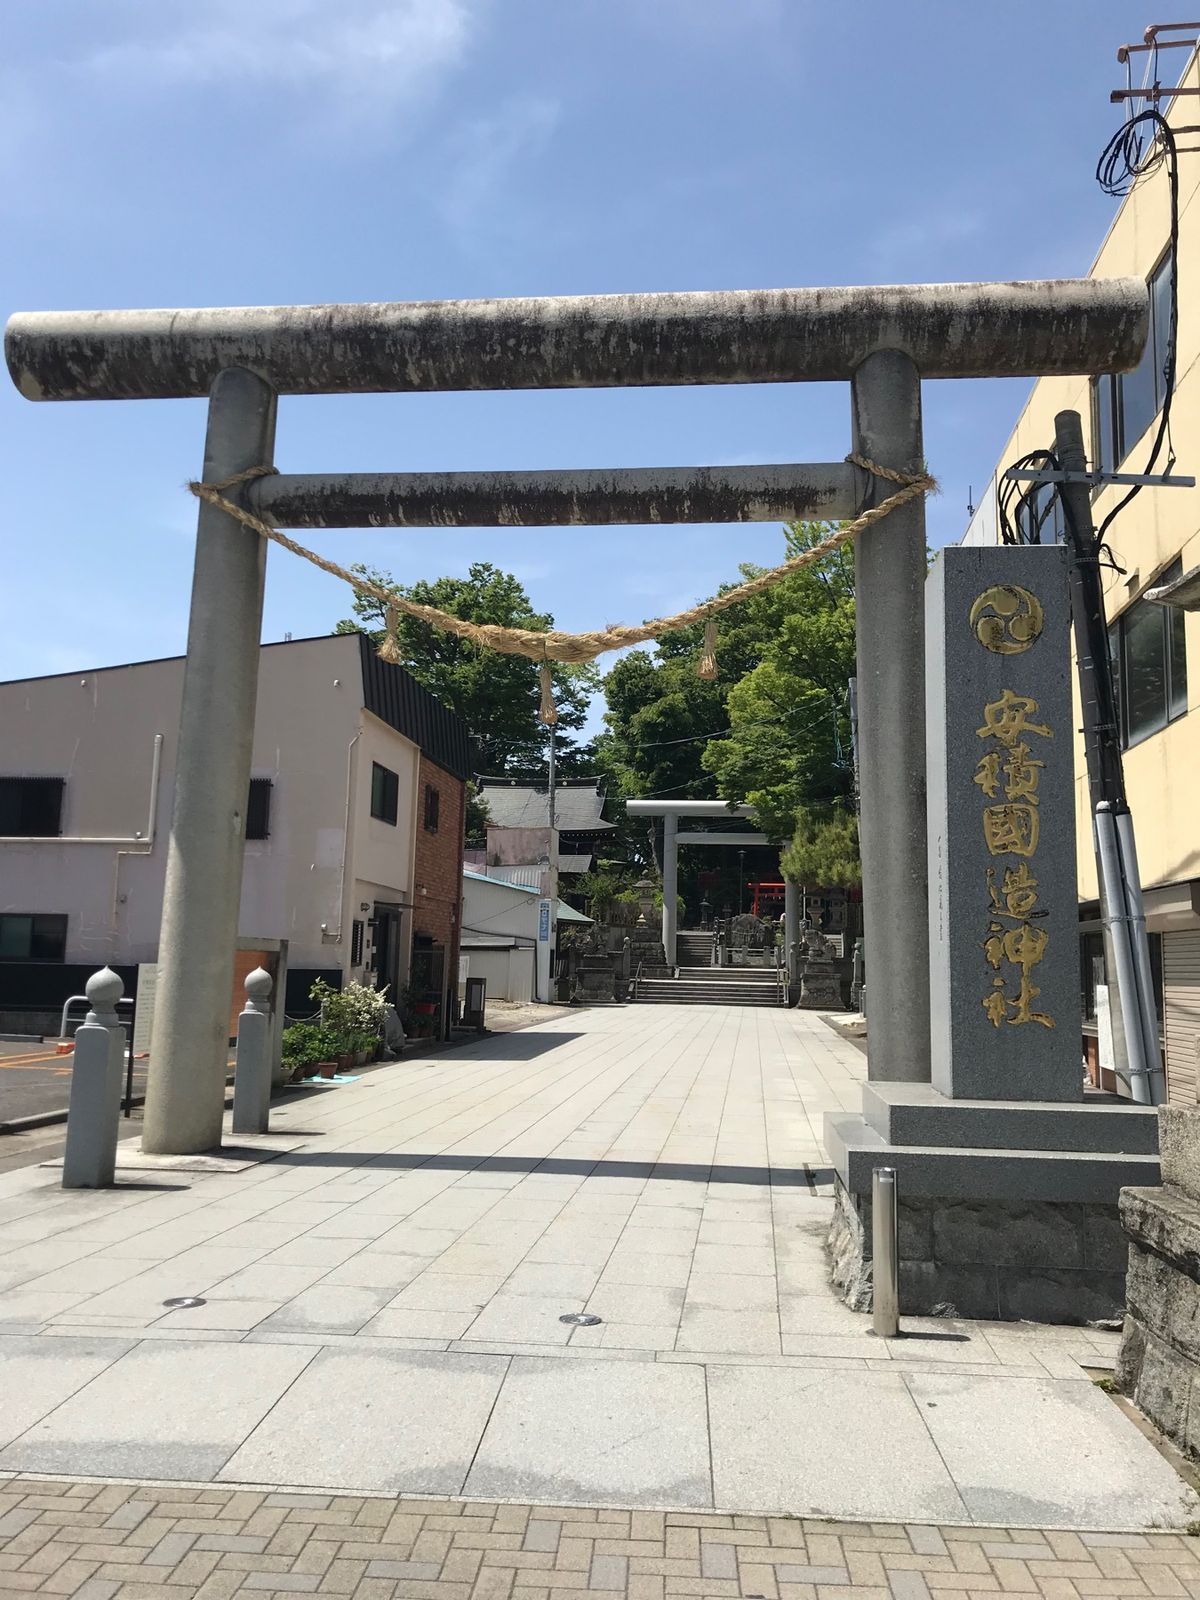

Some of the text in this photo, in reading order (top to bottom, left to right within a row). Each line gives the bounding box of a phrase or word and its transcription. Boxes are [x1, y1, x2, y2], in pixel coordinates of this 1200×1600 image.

[973, 689, 1056, 1028] 安積國造神社
